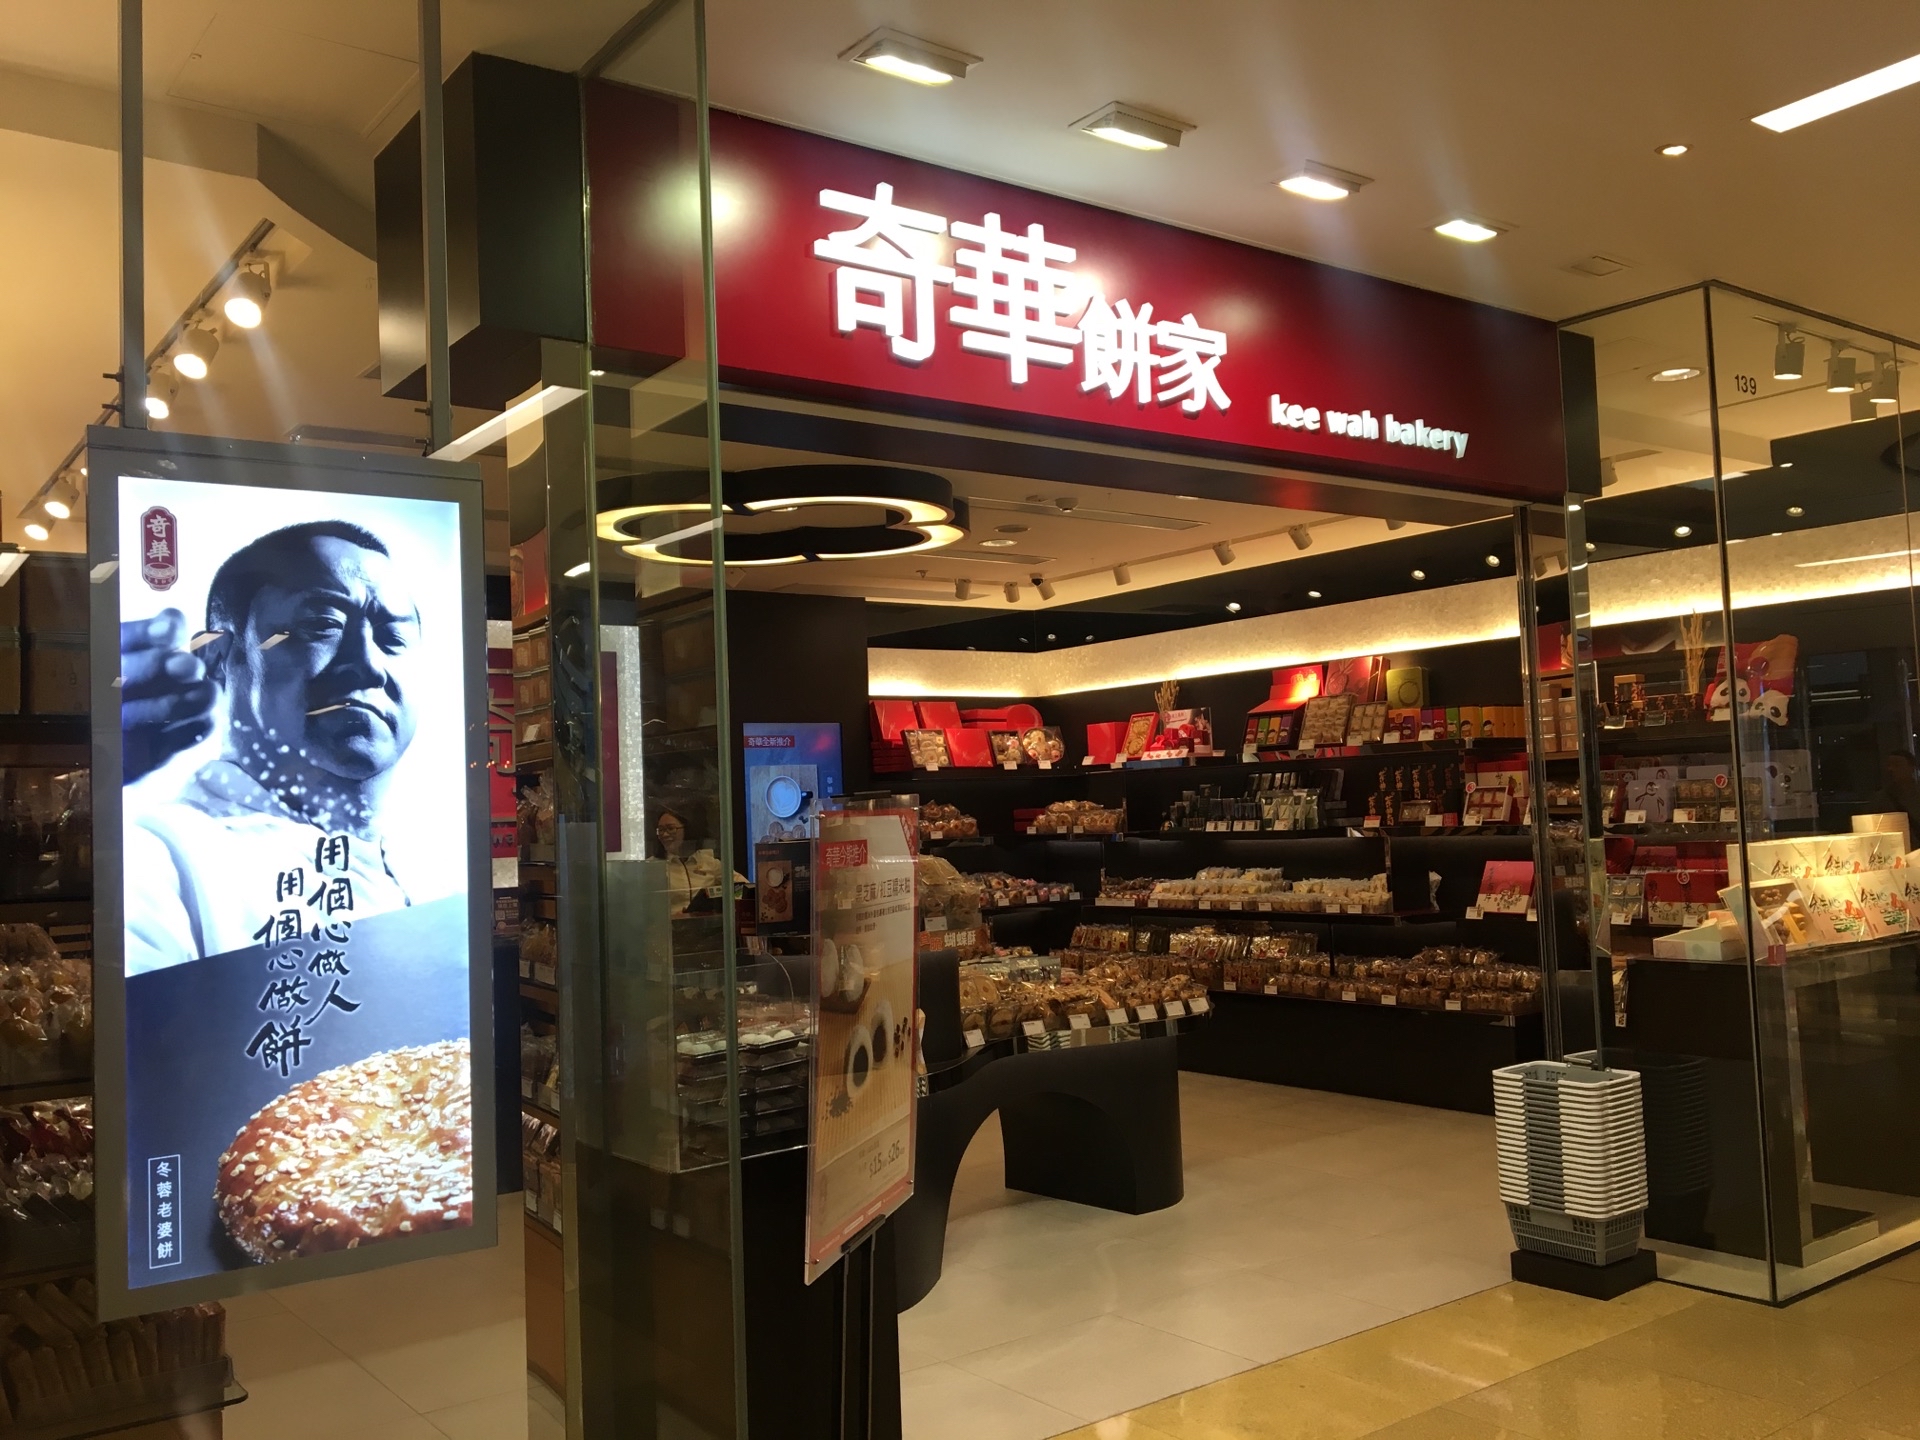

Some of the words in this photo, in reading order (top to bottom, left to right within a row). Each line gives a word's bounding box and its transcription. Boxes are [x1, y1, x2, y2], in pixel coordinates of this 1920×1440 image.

[814, 182, 1231, 412] 奇華餅家
[1271, 394, 1320, 431] kee
[1326, 410, 1379, 440] wah
[1385, 414, 1469, 459] bakery
[1734, 374, 1757, 395] 139
[146, 514, 171, 562] 奇華
[246, 867, 312, 1077] 用個心做餅
[304, 834, 361, 1026] 用個心做人
[156, 1161, 173, 1259] 冬蓉老婆餅
